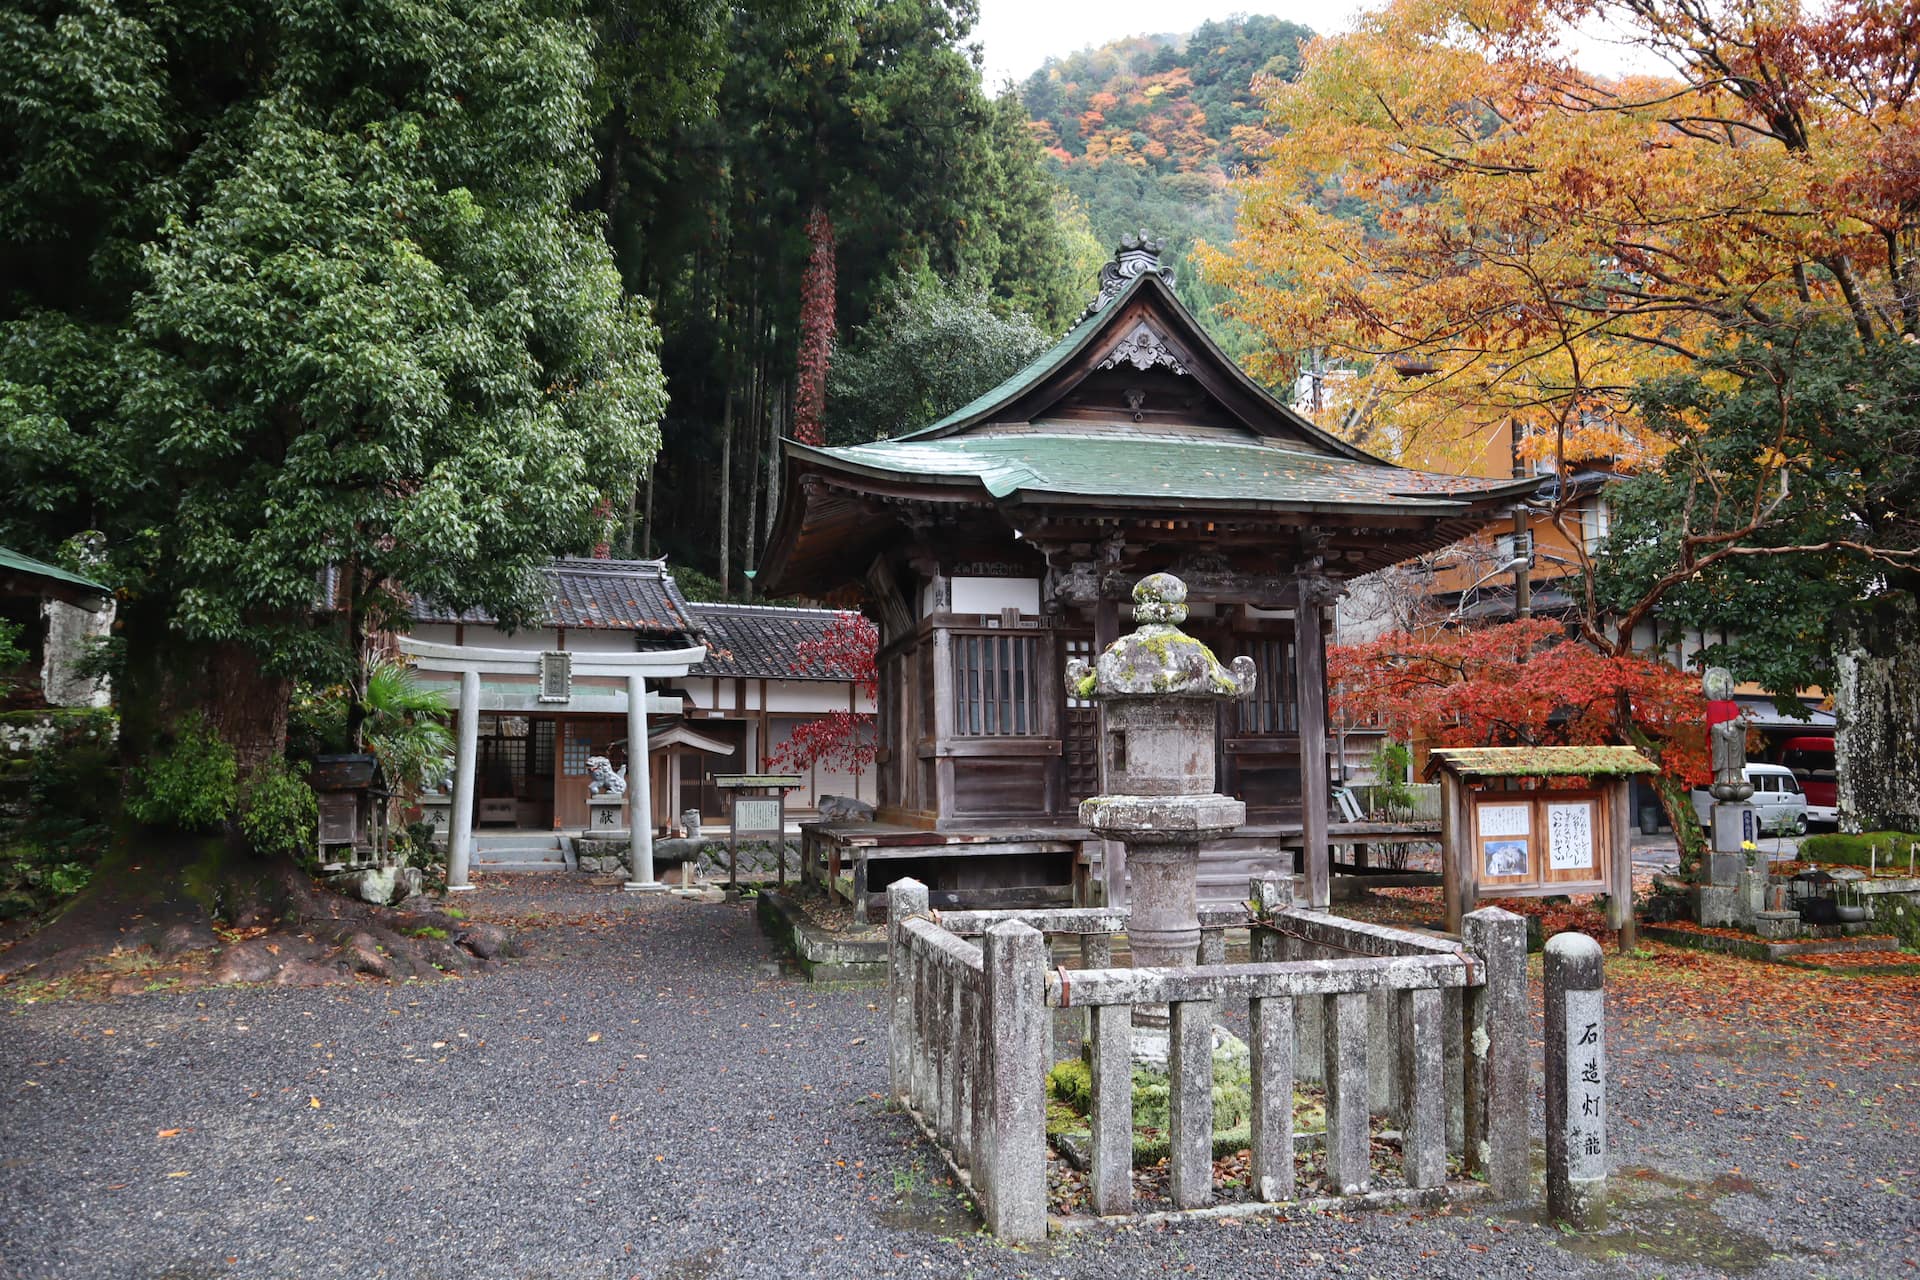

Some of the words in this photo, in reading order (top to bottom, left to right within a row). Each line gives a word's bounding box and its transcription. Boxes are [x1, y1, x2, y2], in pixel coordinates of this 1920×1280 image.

[600, 810, 614, 825] 献
[1577, 1022, 1602, 1156] 石造灯籠
